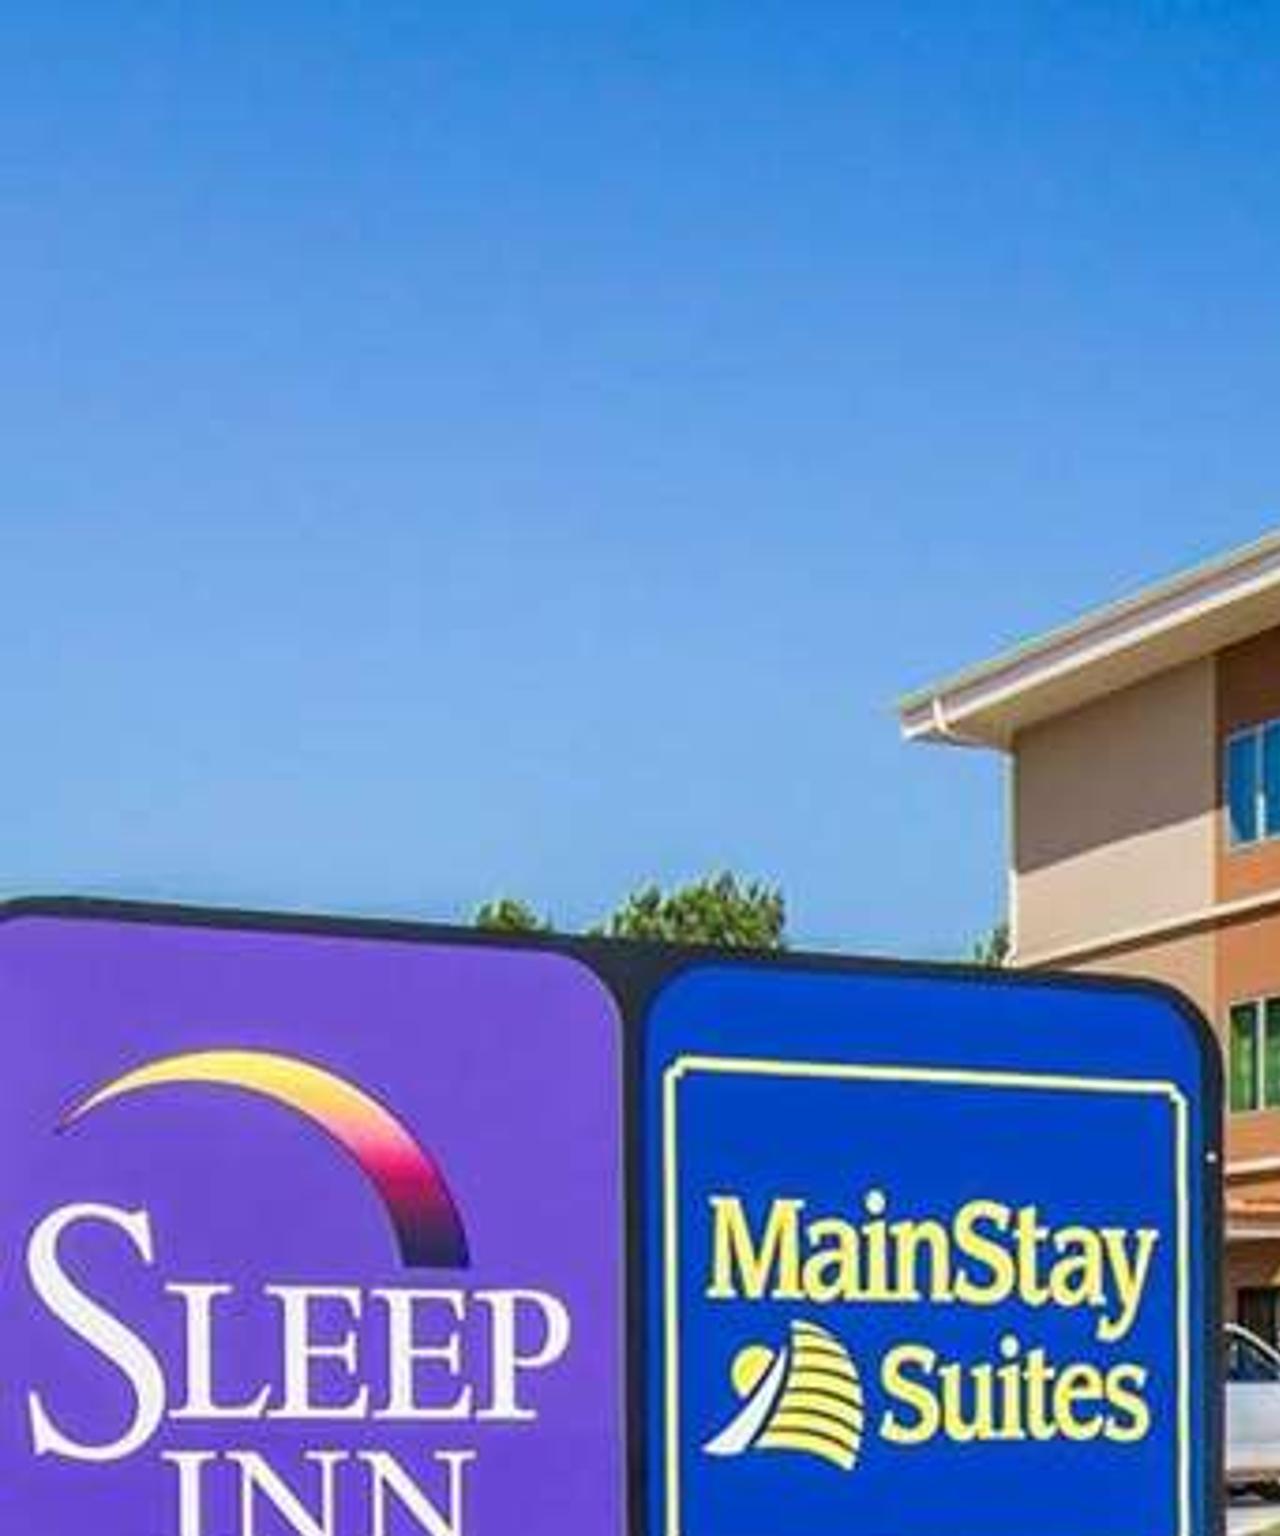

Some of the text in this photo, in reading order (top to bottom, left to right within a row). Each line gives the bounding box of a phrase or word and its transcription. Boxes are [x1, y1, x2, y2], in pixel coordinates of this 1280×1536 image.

[26, 1202, 571, 1461] SLEEP
[706, 1189, 1158, 1340] MainStay
[879, 1337, 1151, 1444] Suites
